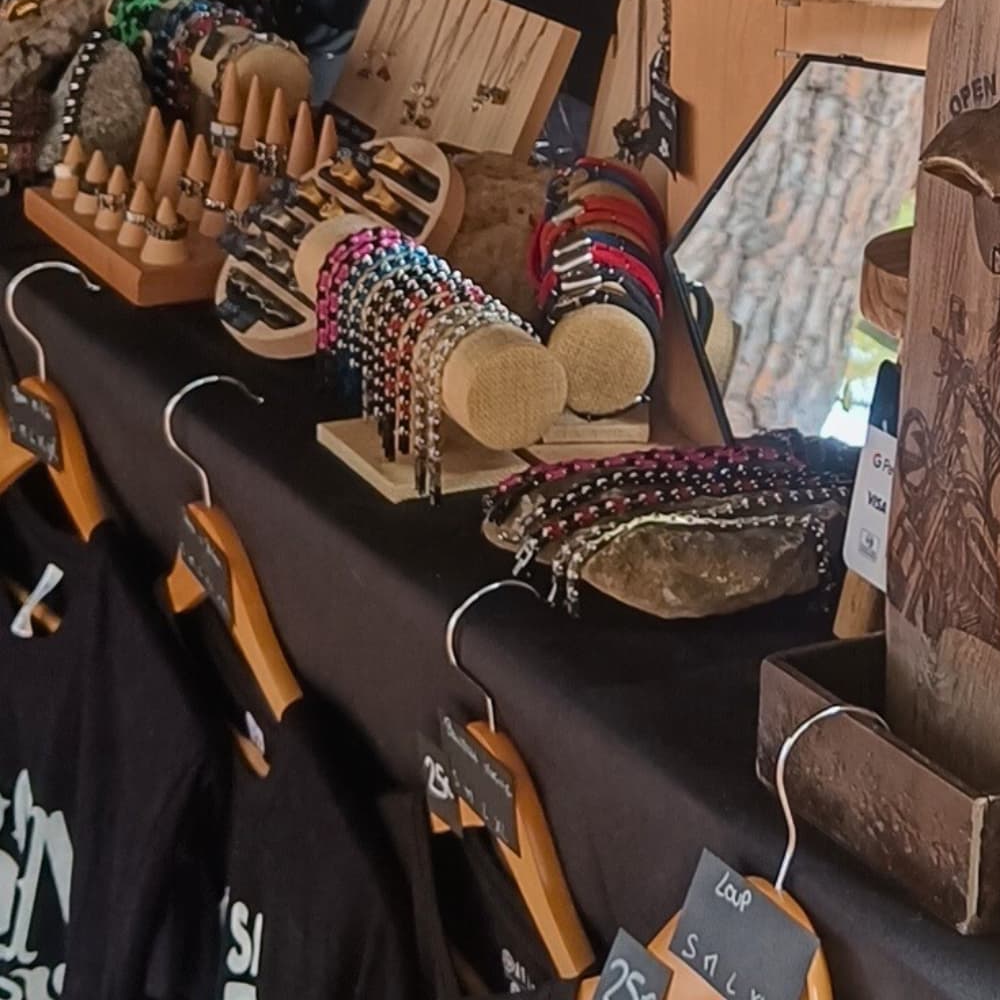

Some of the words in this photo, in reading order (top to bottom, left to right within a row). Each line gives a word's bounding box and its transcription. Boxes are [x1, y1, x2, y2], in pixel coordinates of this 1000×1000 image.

[949, 73, 997, 117] OPEN
[867, 490, 887, 514] VISA
[601, 957, 657, 1000] 25
